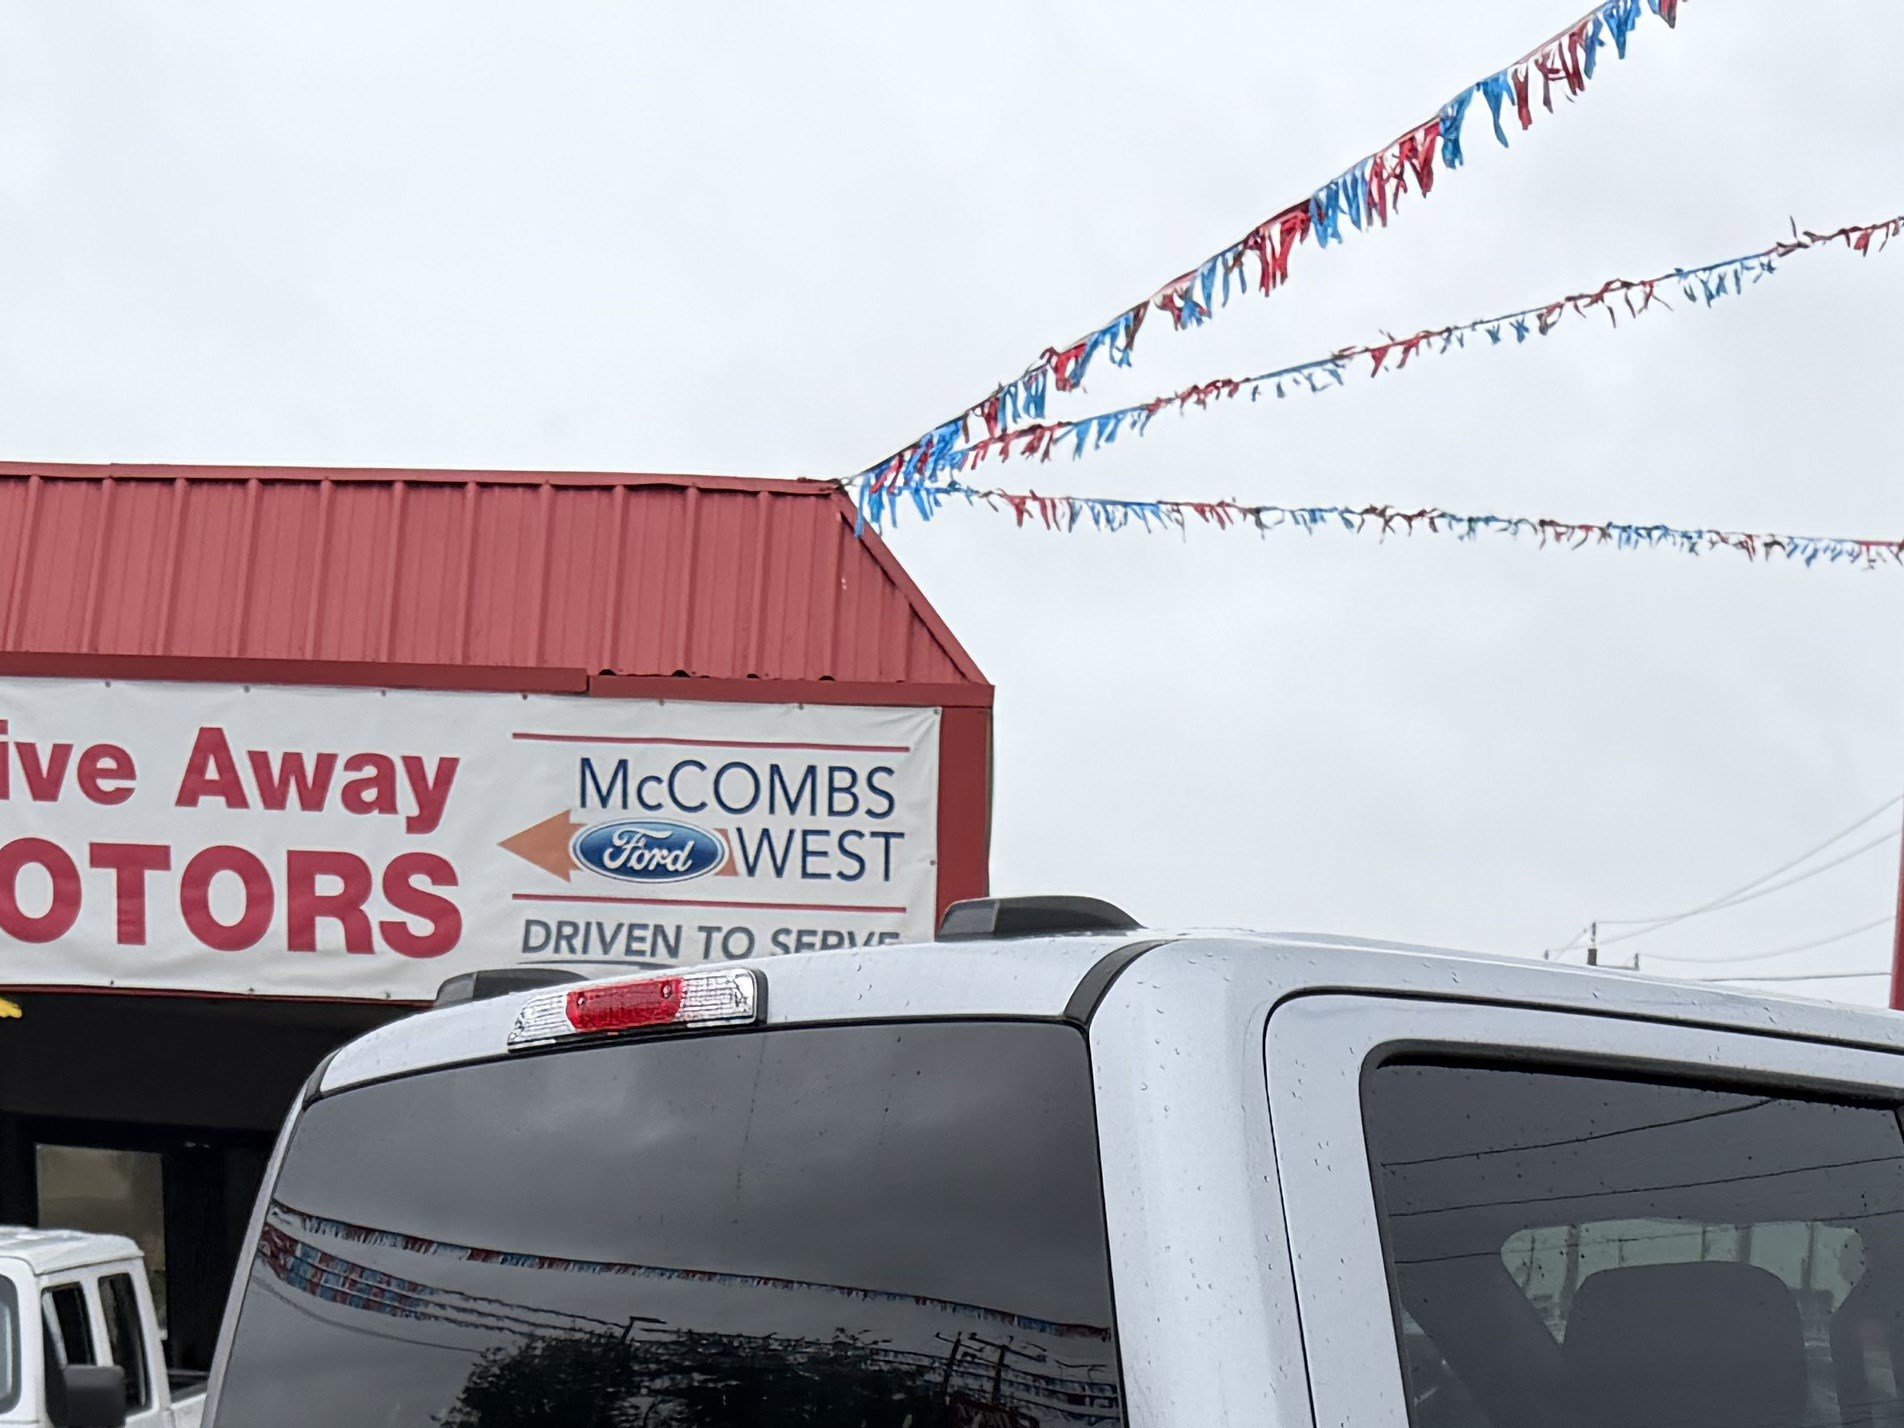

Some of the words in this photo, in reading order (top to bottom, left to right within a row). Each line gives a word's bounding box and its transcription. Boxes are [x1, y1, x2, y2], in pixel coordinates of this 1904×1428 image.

[174, 726, 461, 835] Away
[579, 757, 896, 820] McCOMBS
[602, 826, 696, 873] Ford
[736, 827, 906, 882] WEST
[521, 919, 683, 958] DRIVEN
[697, 925, 755, 960] TO
